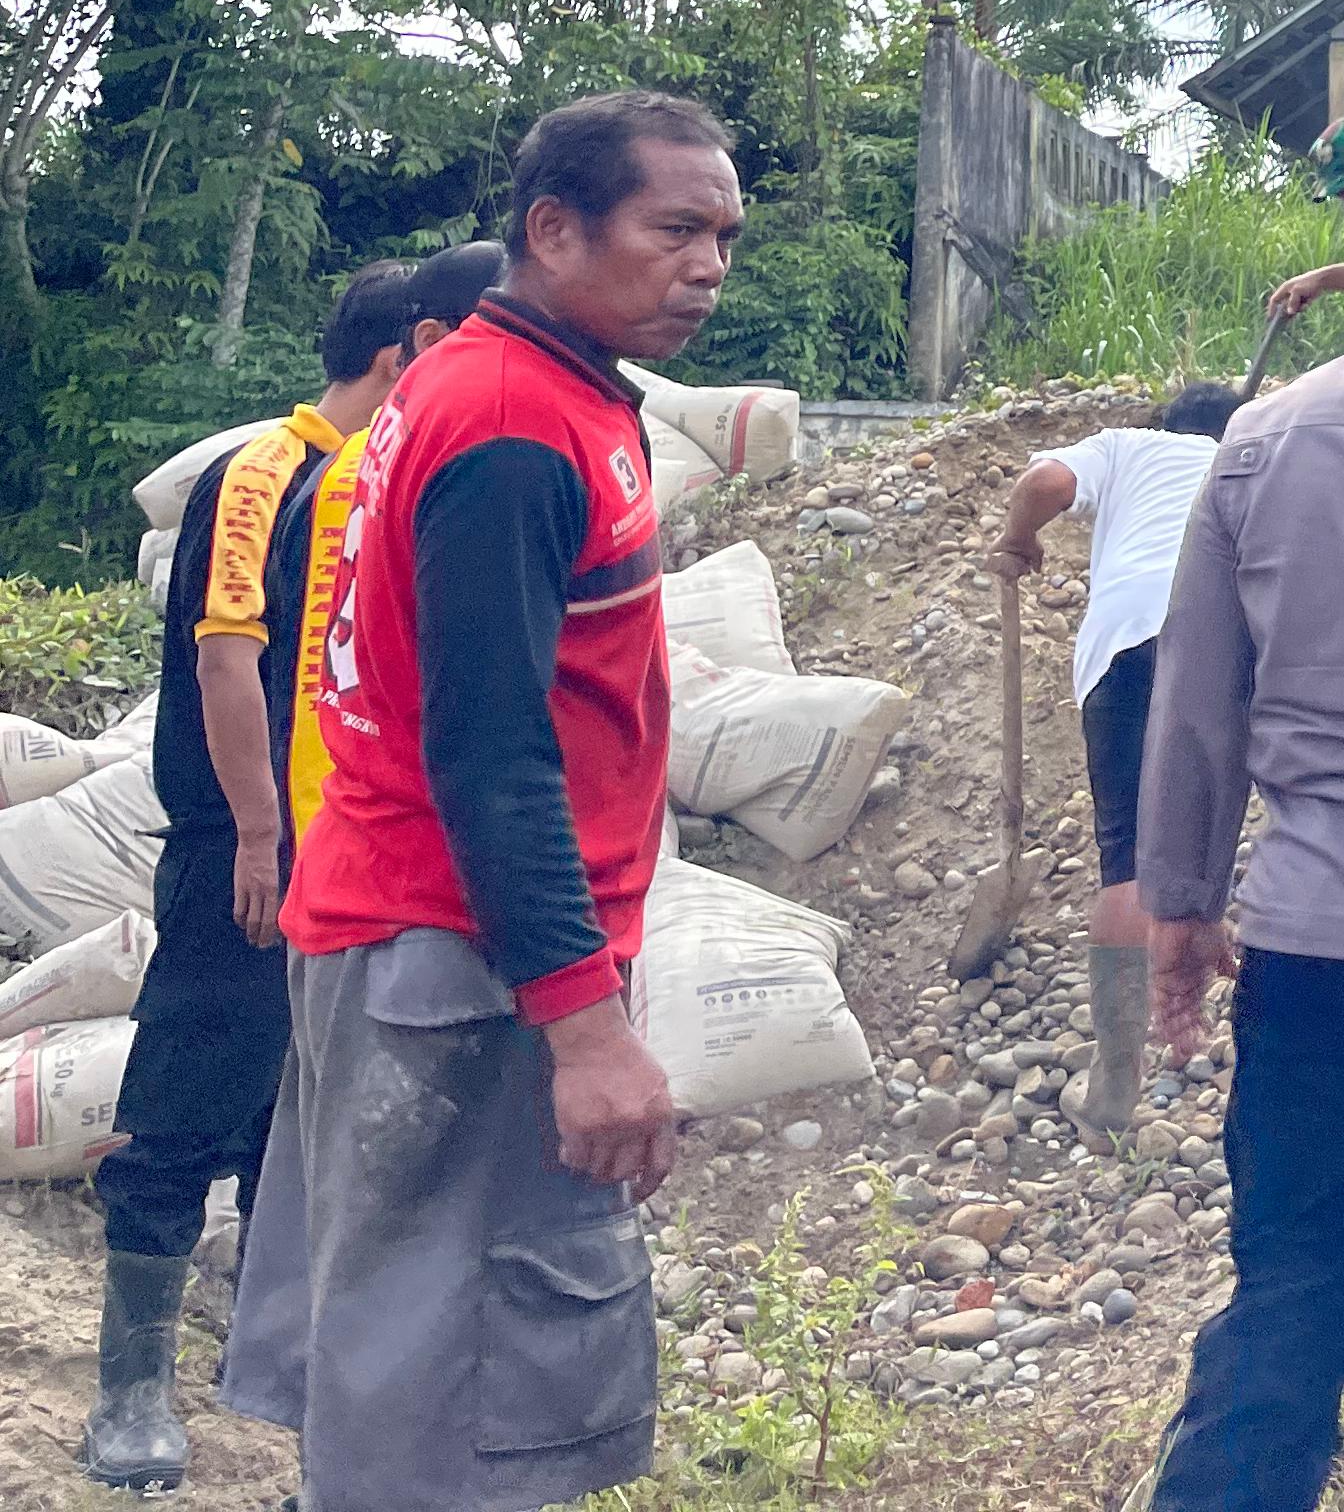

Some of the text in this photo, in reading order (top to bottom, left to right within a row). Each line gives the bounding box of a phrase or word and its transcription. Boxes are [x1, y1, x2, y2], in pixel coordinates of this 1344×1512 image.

[616, 455, 637, 491] 3
[54, 1059, 74, 1079] 50
[81, 1101, 114, 1126] SE
